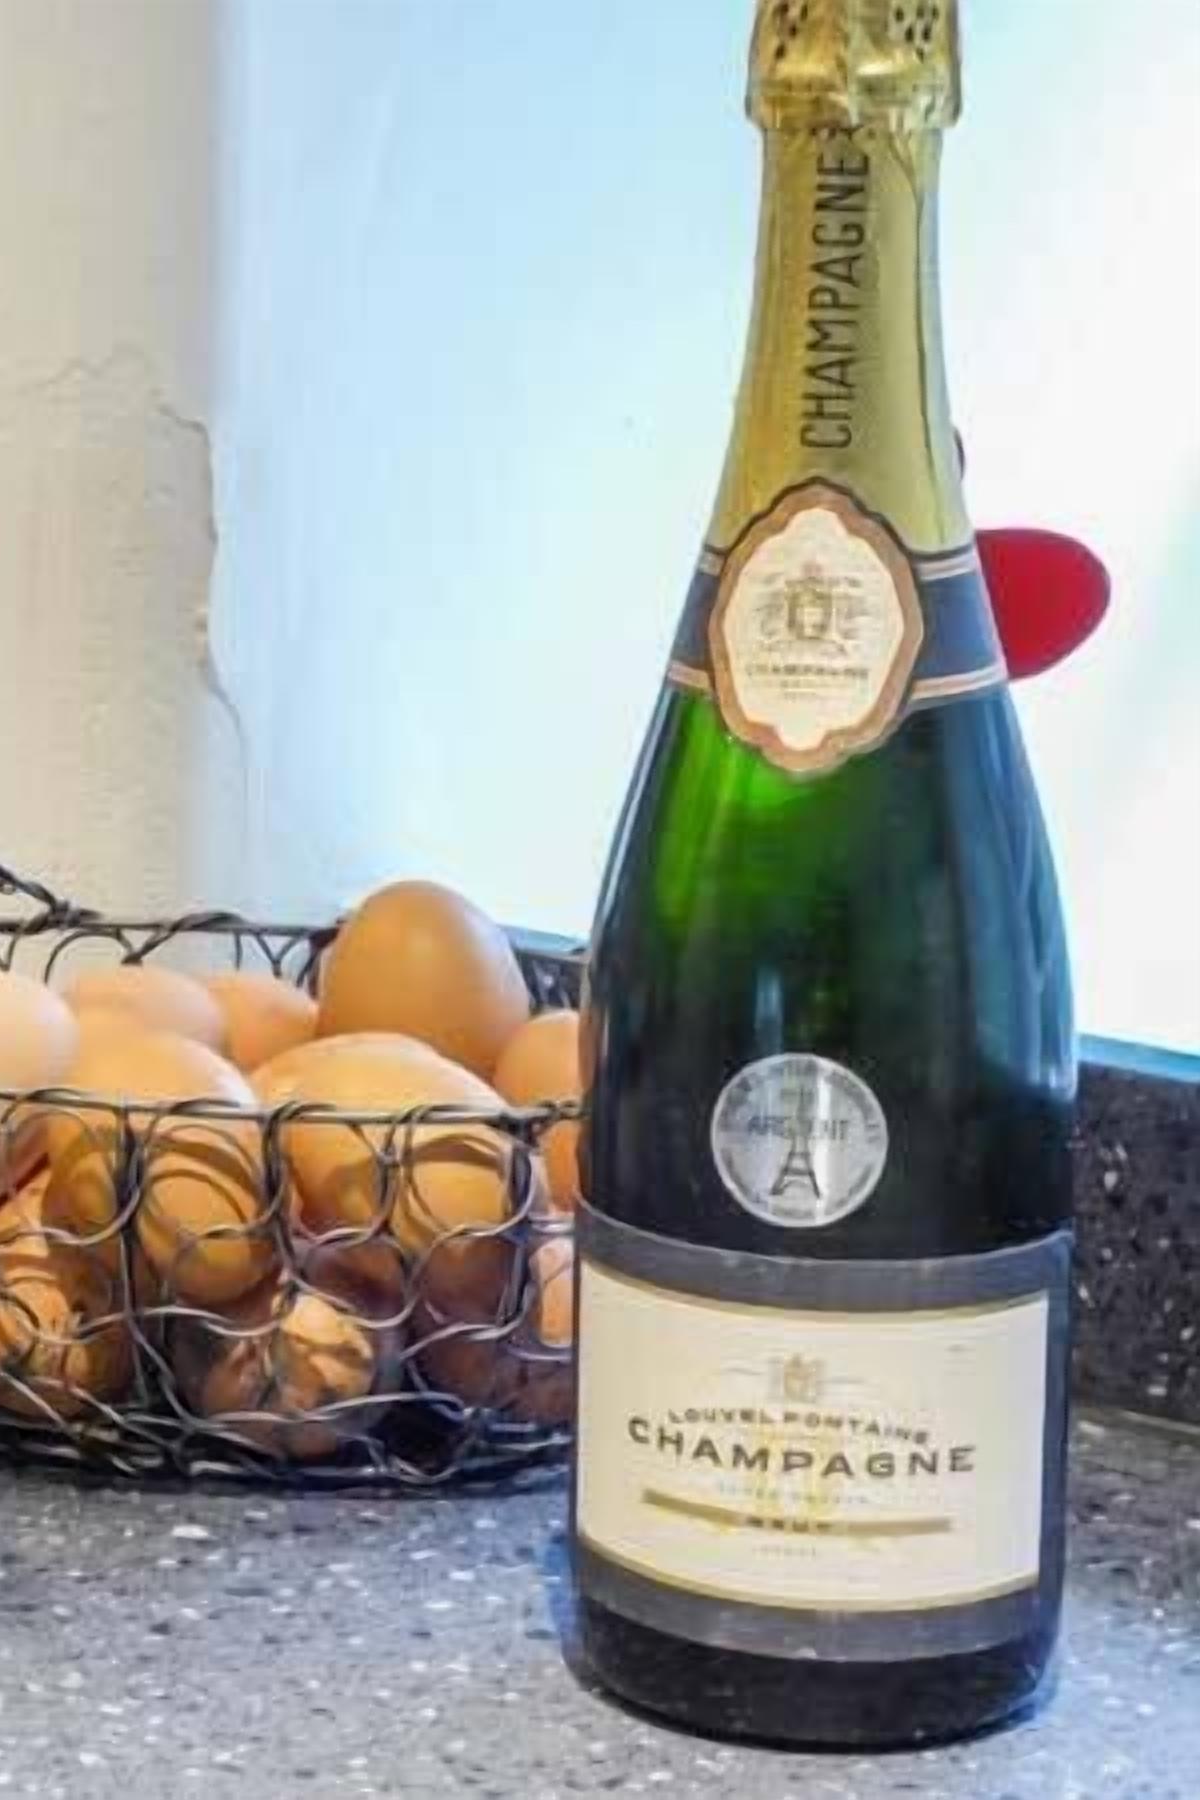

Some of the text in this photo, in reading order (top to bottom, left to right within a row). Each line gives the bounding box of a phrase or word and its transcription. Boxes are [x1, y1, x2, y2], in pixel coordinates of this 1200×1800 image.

[800, 152, 869, 451] CHAMPAGNE
[628, 1414, 976, 1479] CHAMPAGNE
[668, 1406, 774, 1424] LOUVEL
